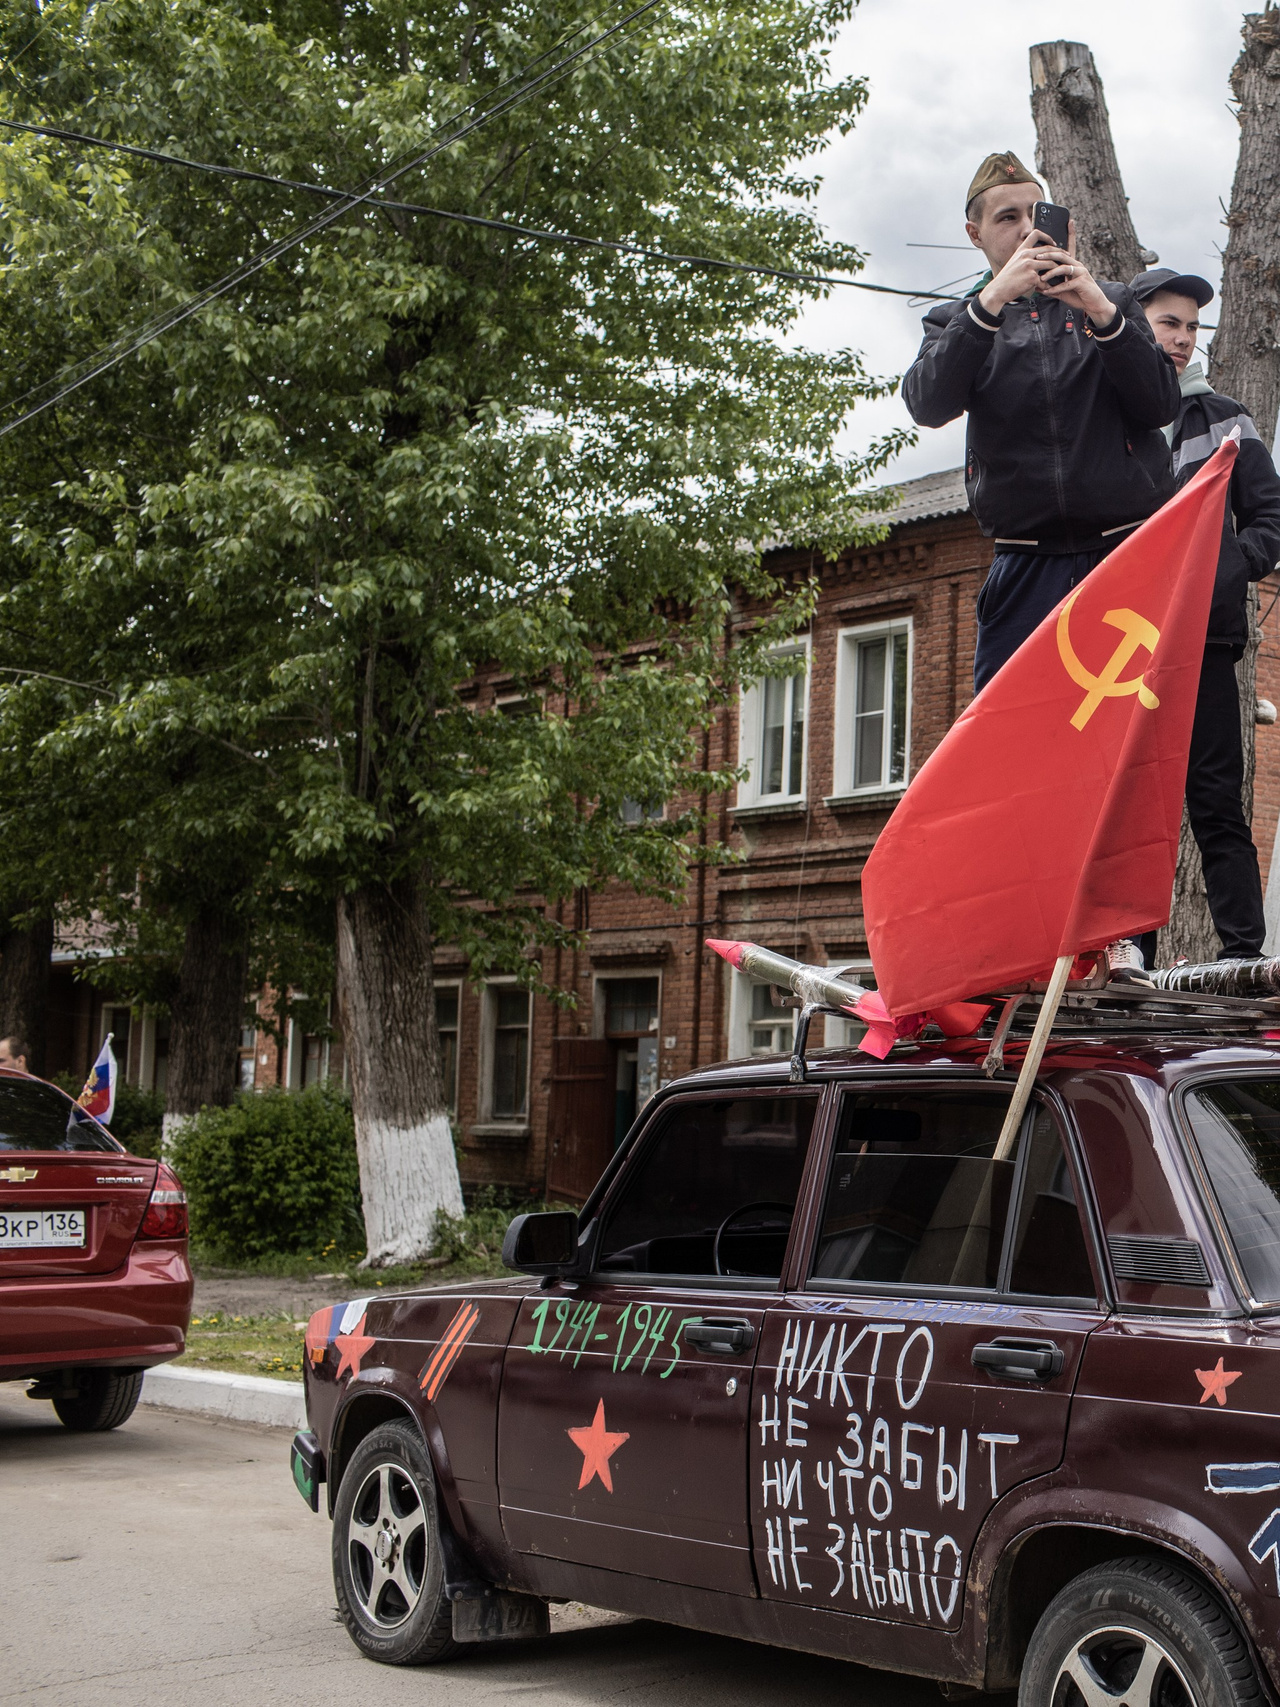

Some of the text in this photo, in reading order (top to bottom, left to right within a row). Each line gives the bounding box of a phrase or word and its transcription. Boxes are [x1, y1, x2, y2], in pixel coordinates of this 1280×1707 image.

[45, 1213, 79, 1231] 136
[52, 1230, 70, 1238] RUS
[526, 1298, 703, 1379] 1941-1945
[775, 1318, 934, 1412] НИКТО
[758, 1394, 1020, 1512] НЕ ЗАБЫТ
[761, 1457, 893, 1522] НИ ЧТО
[764, 1516, 963, 1624] НЕ ЗАБЫТО
